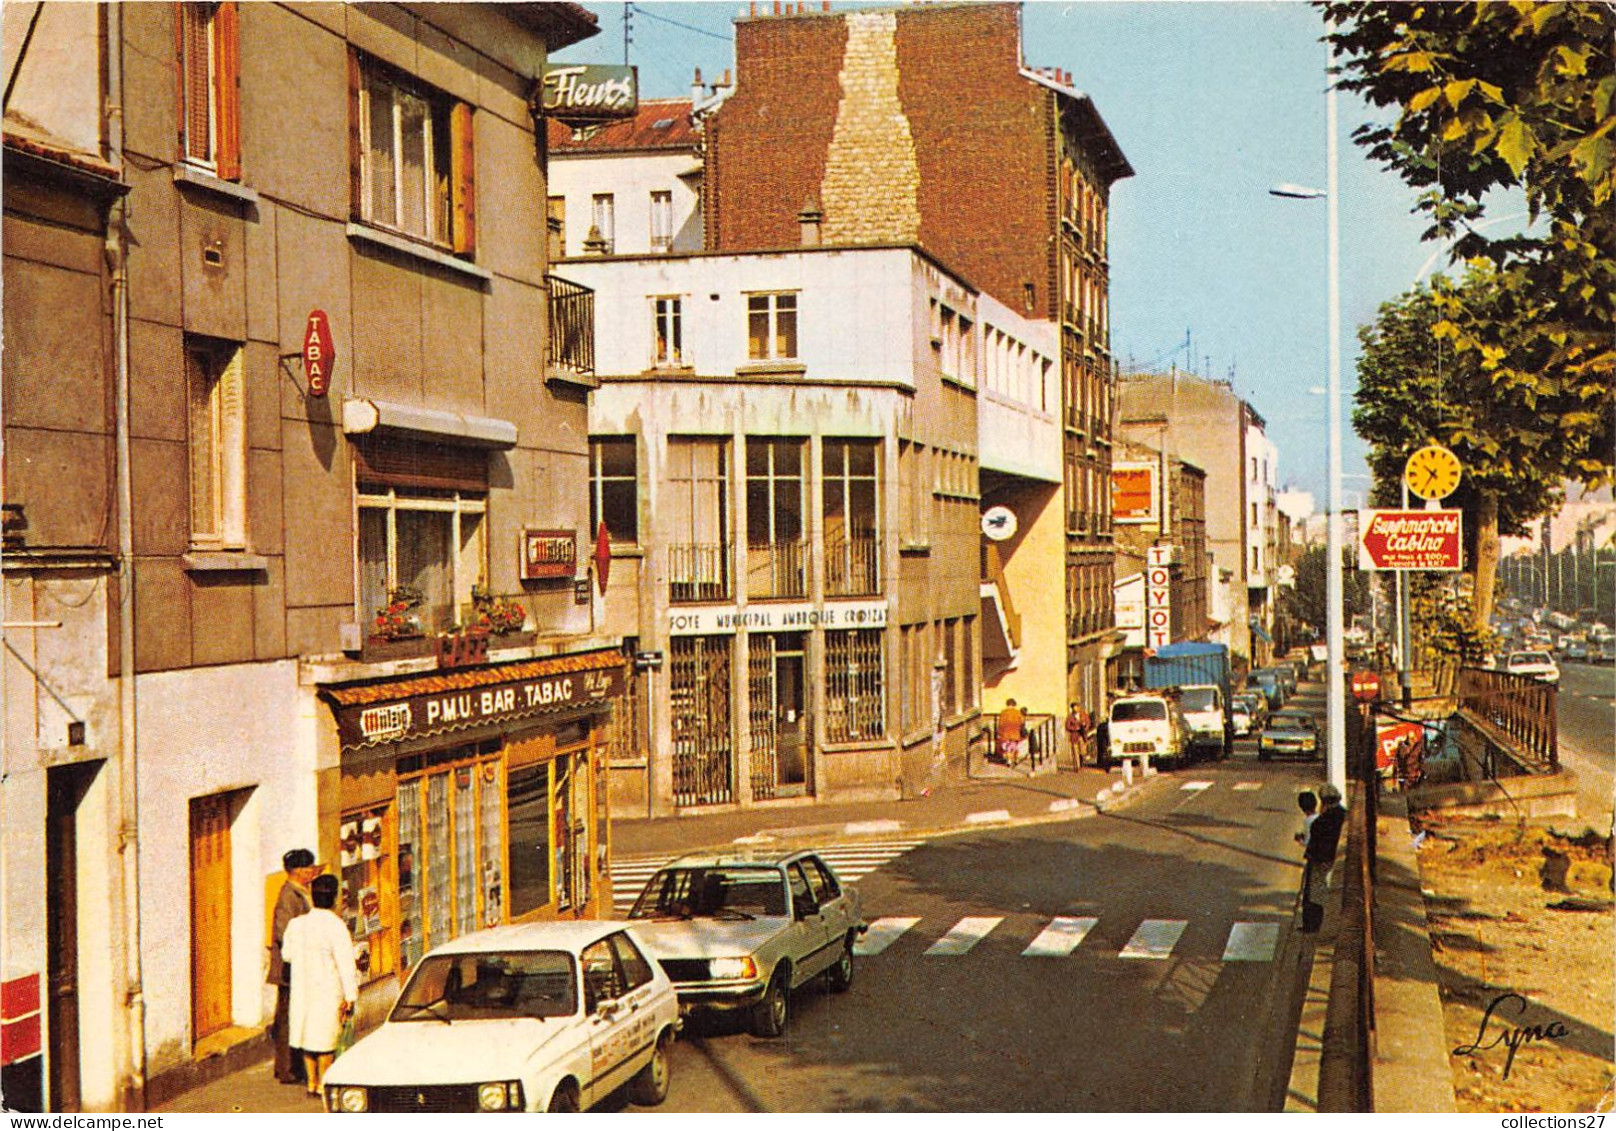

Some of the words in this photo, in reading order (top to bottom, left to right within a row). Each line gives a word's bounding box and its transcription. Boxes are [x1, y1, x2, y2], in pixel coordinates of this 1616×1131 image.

[543, 66, 631, 110] Fleurs
[308, 317, 322, 390] TABAC
[1151, 550, 1168, 647] TOYOT
[481, 687, 516, 716] BAR
[525, 678, 573, 708] TABAC
